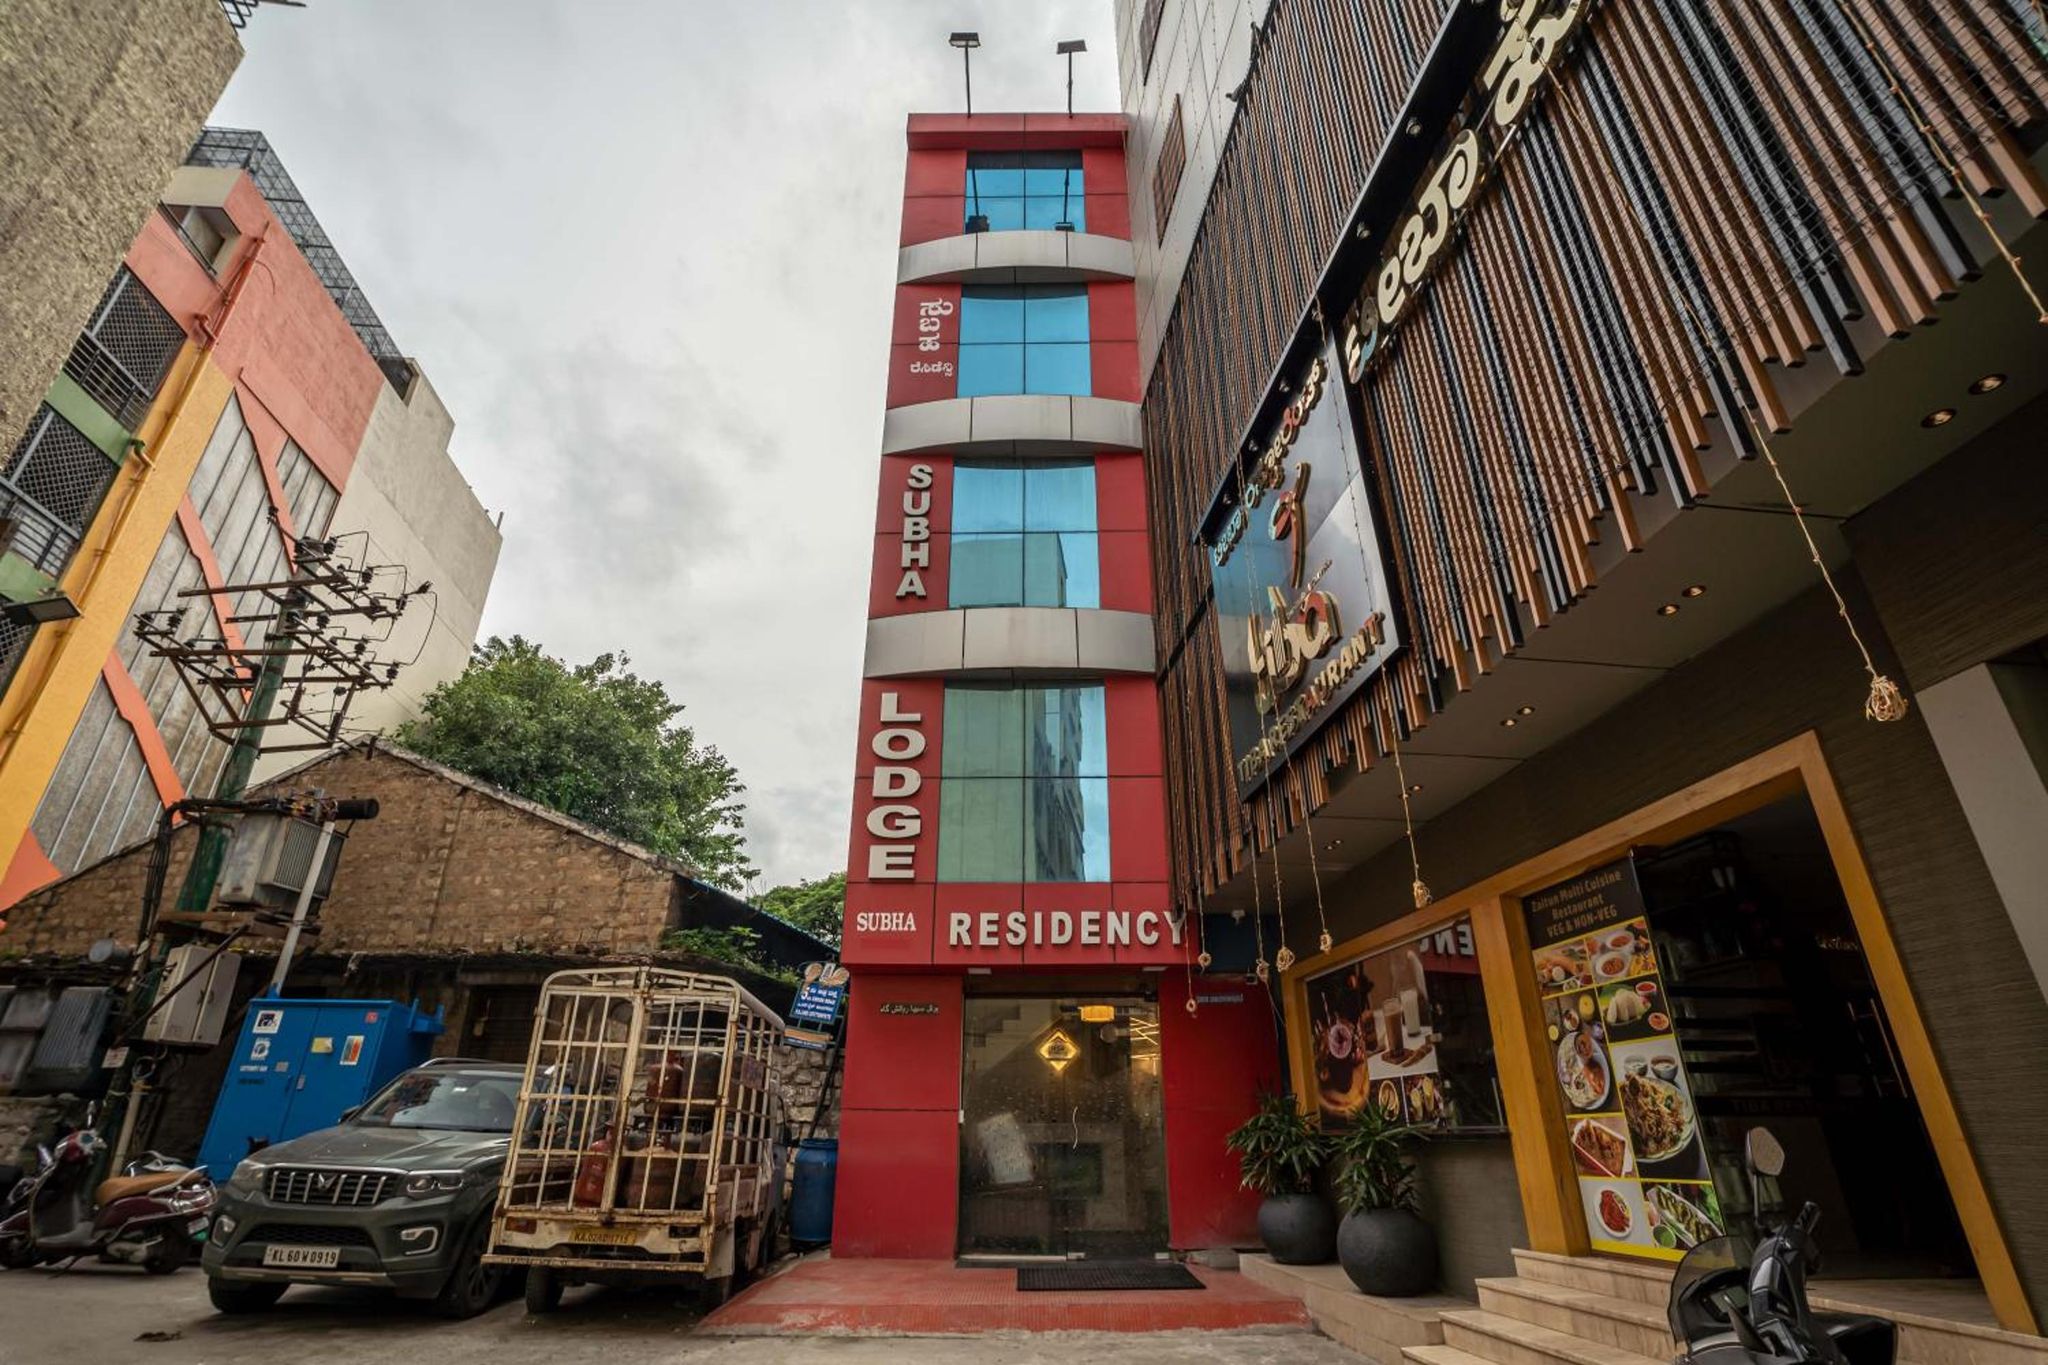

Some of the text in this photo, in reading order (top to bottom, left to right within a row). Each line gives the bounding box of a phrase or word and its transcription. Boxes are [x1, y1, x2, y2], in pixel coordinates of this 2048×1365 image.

[896, 463, 933, 598] SUBHA
[866, 692, 927, 880] LODGE
[857, 912, 917, 932] SUBHA
[949, 911, 1185, 947] RESIDENCY
